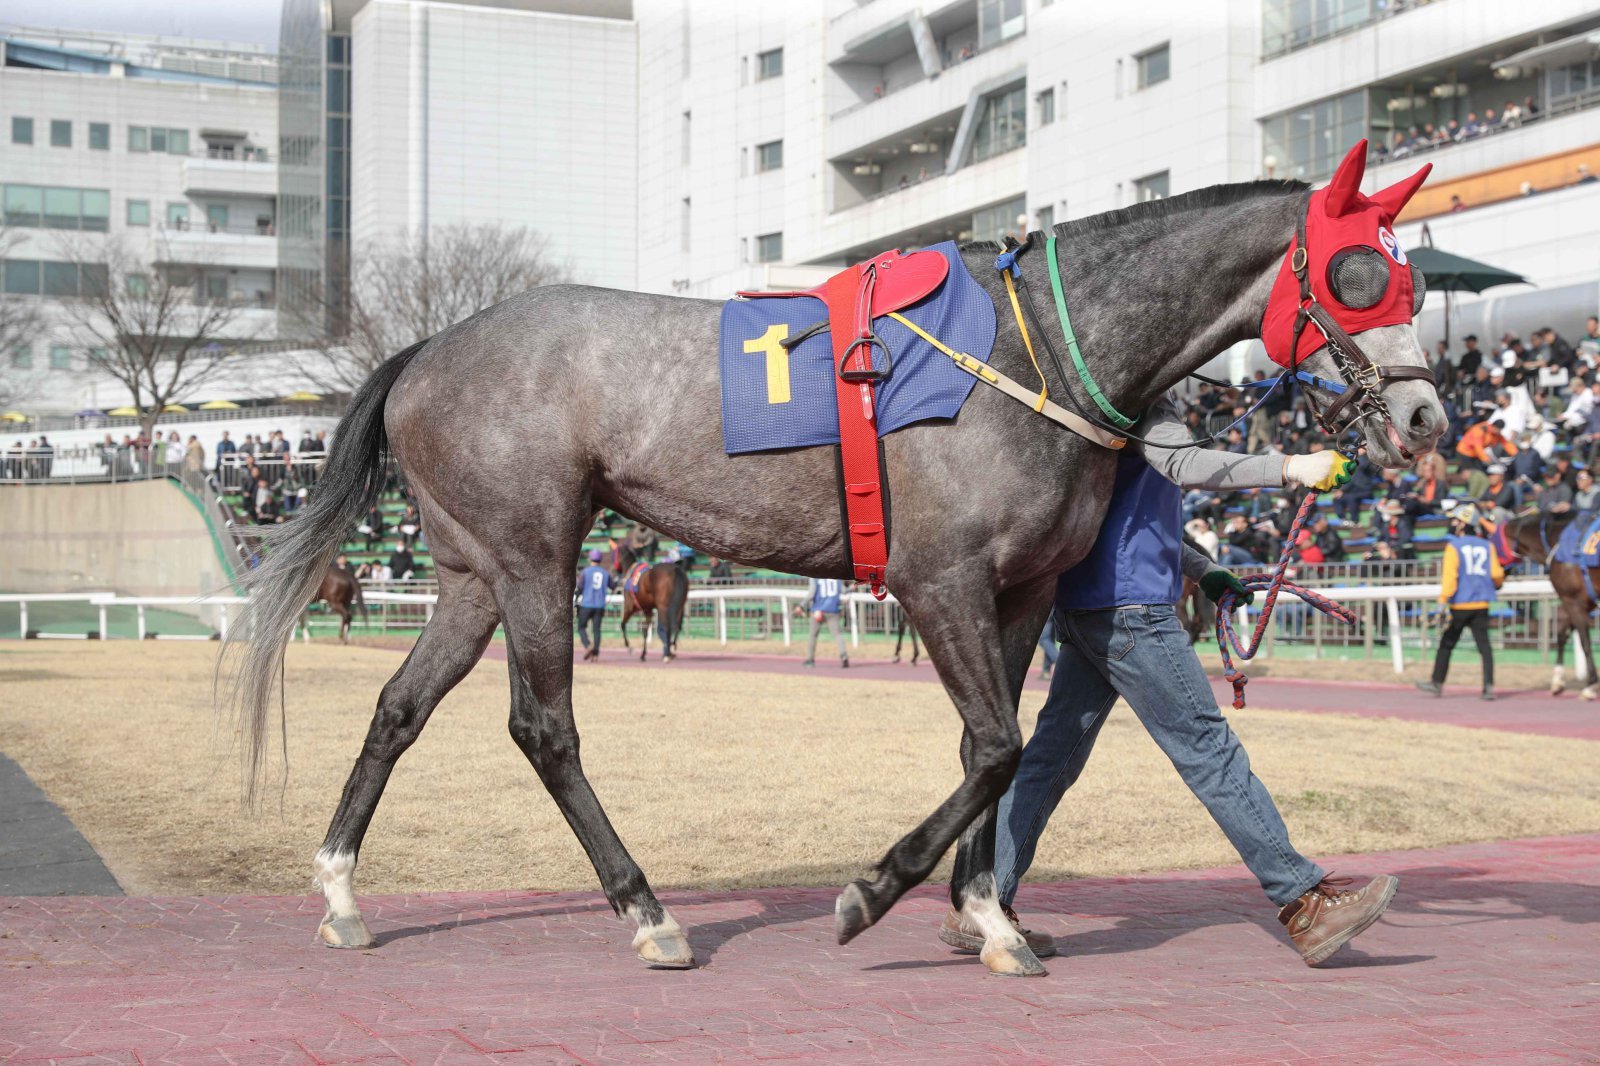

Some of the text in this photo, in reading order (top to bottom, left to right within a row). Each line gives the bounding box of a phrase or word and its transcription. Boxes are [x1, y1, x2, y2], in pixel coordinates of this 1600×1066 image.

[743, 323, 791, 404] 1
[1461, 545, 1487, 576] 12
[593, 572, 603, 590] 9
[818, 579, 838, 598] 10
